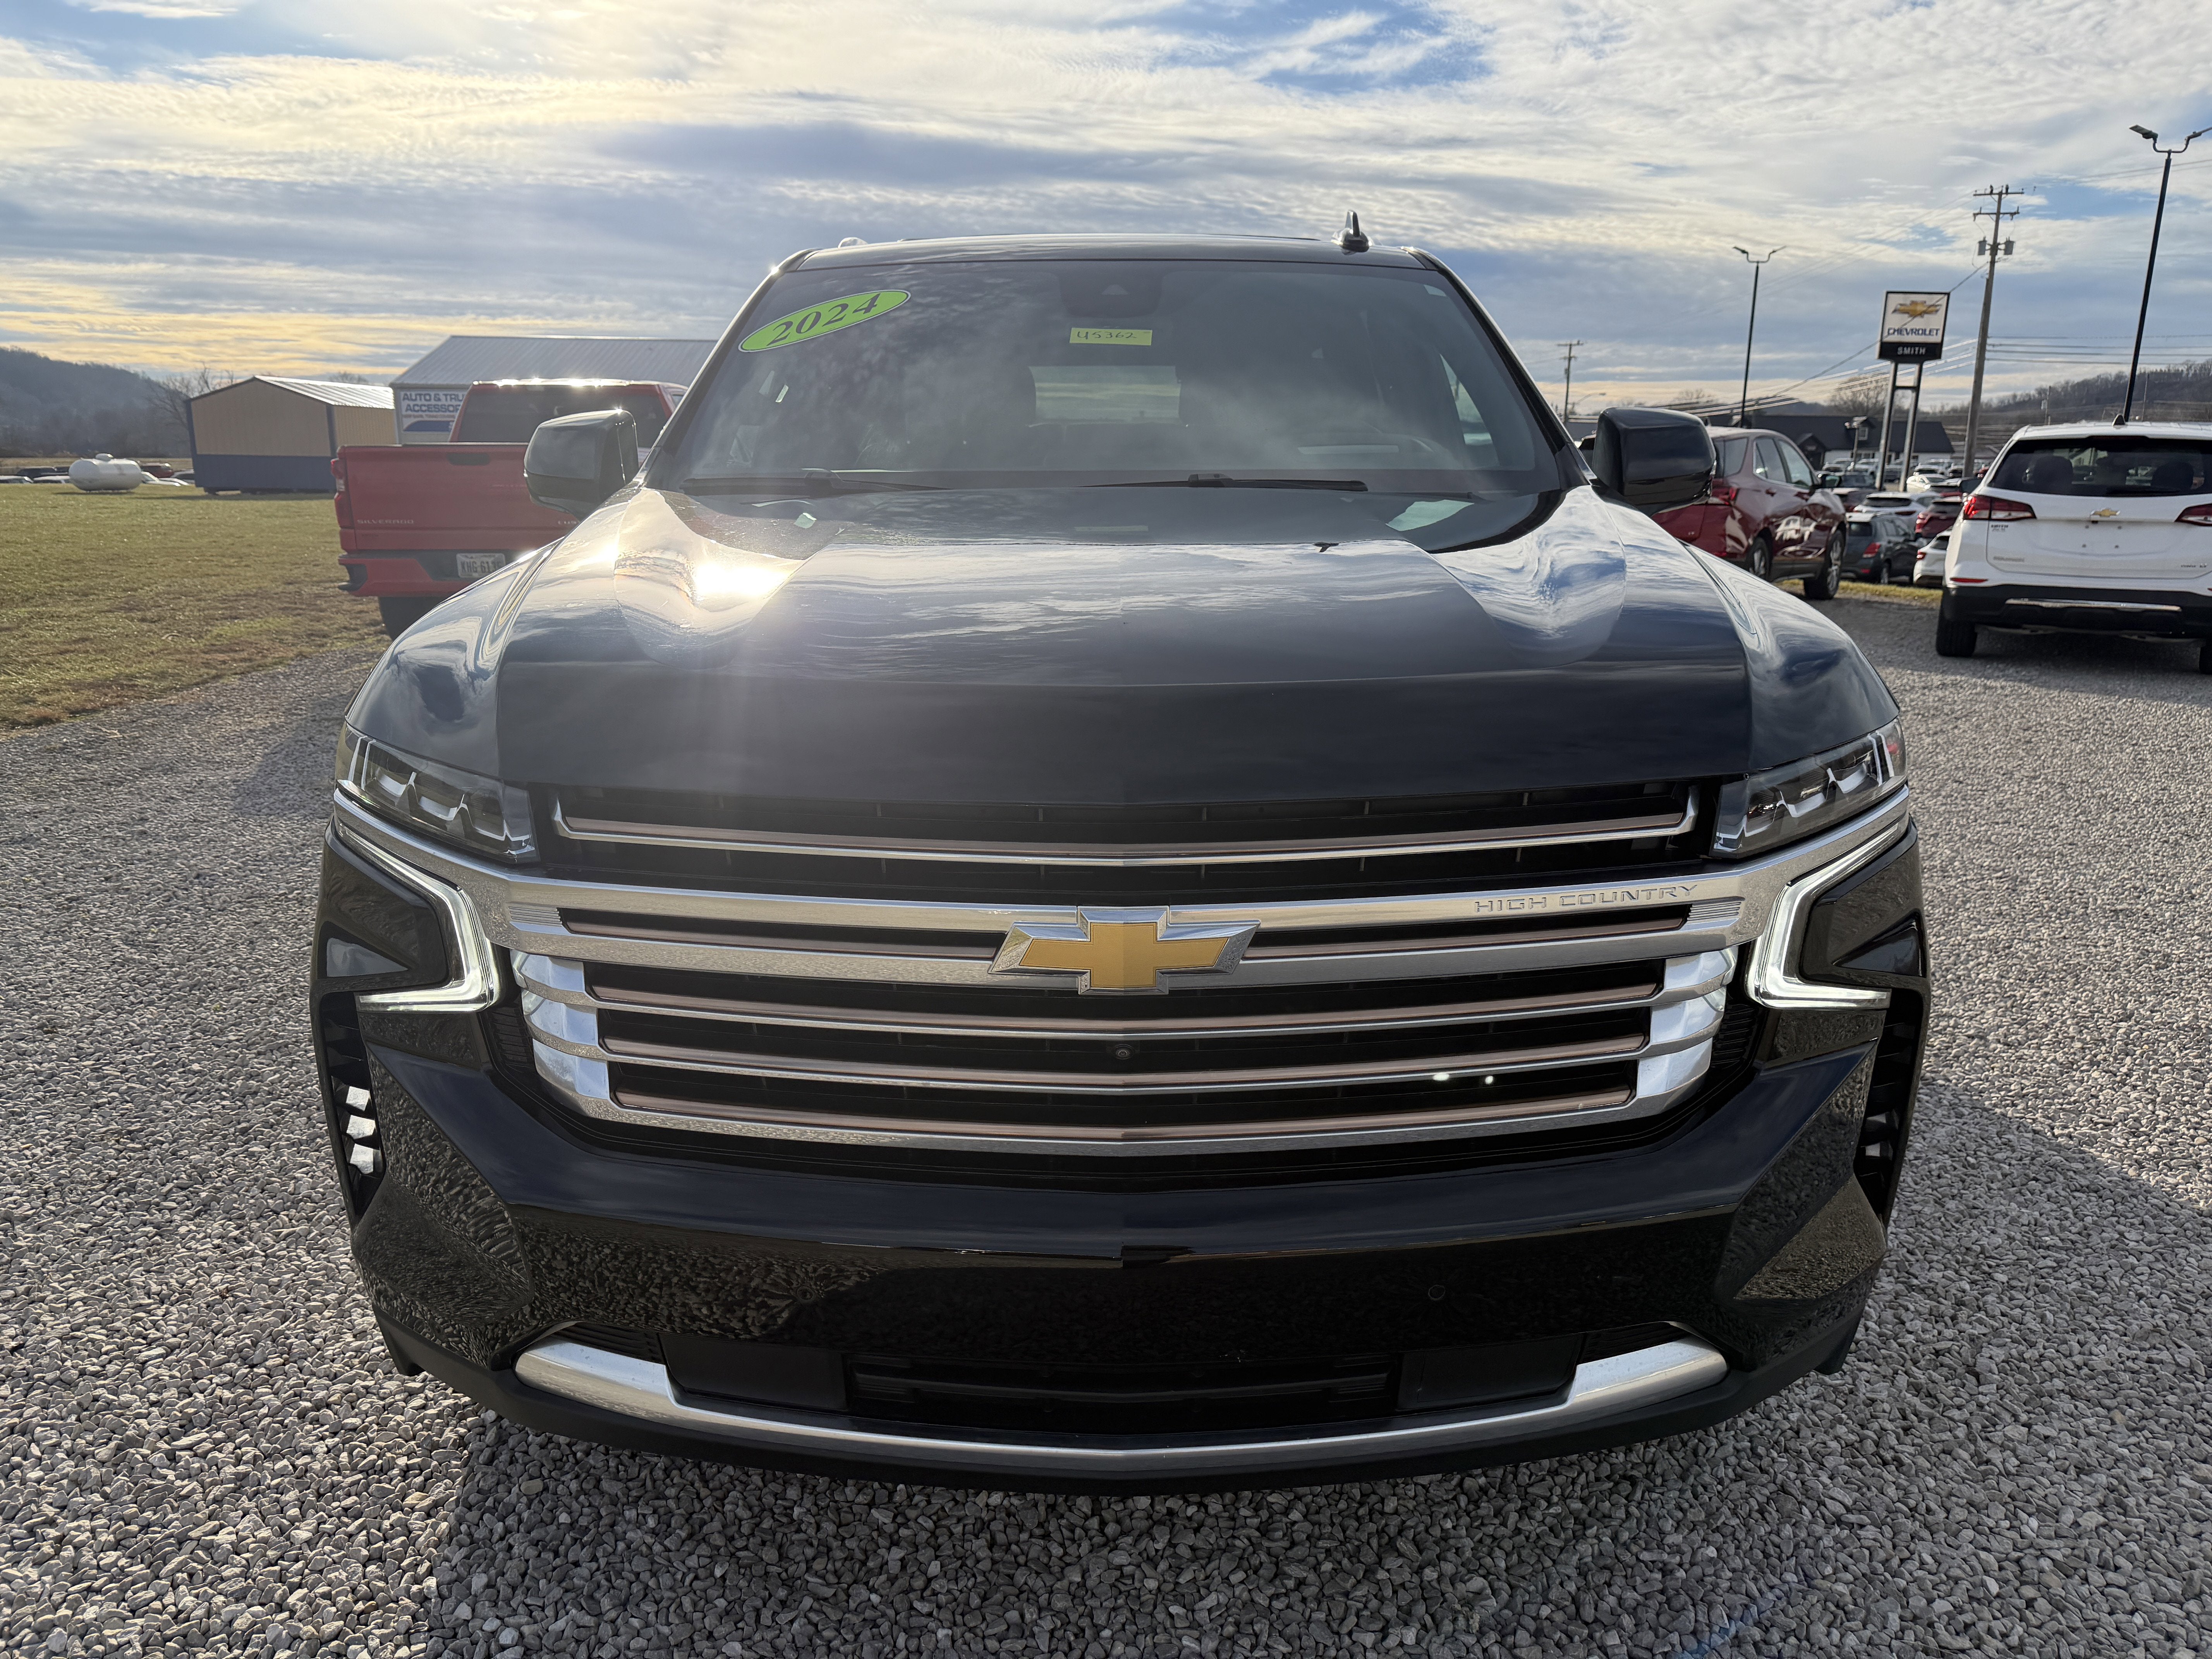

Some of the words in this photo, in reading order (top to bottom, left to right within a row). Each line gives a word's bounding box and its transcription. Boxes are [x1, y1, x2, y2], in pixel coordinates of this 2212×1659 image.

[766, 292, 881, 346] 2024
[1887, 328, 1940, 336] CHEVROLET
[1897, 346, 1927, 355] SMITH
[402, 393, 431, 401] AUTO
[434, 393, 441, 401] &
[1474, 896, 1547, 912] HIGH
[1559, 884, 1698, 907] COUNTRY
